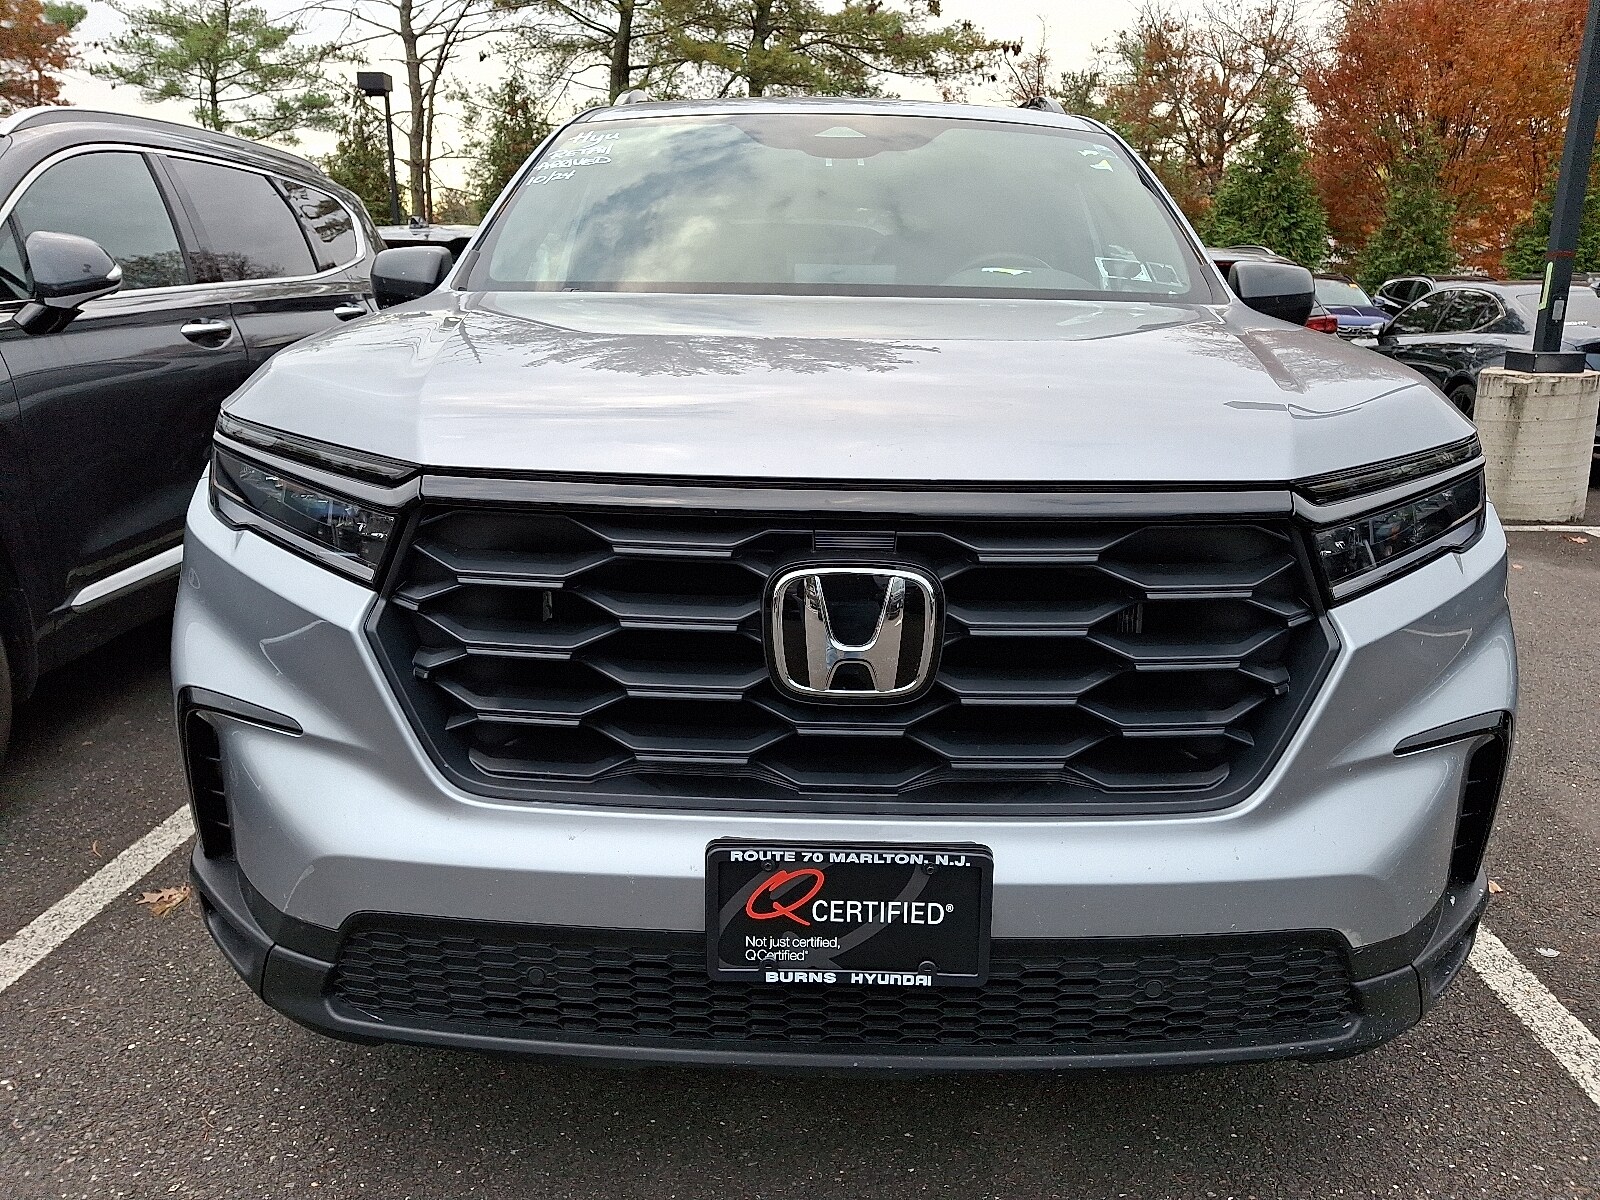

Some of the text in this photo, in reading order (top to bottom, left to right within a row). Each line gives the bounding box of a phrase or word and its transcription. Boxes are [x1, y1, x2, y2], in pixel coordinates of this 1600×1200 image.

[526, 170, 576, 186] 10/24
[730, 850, 796, 862] ROUTE
[802, 851, 825, 863] 70
[935, 854, 971, 867] N.J.
[745, 935, 841, 950] Not just certified,
[765, 971, 932, 987] BURNS HYUNDAI
